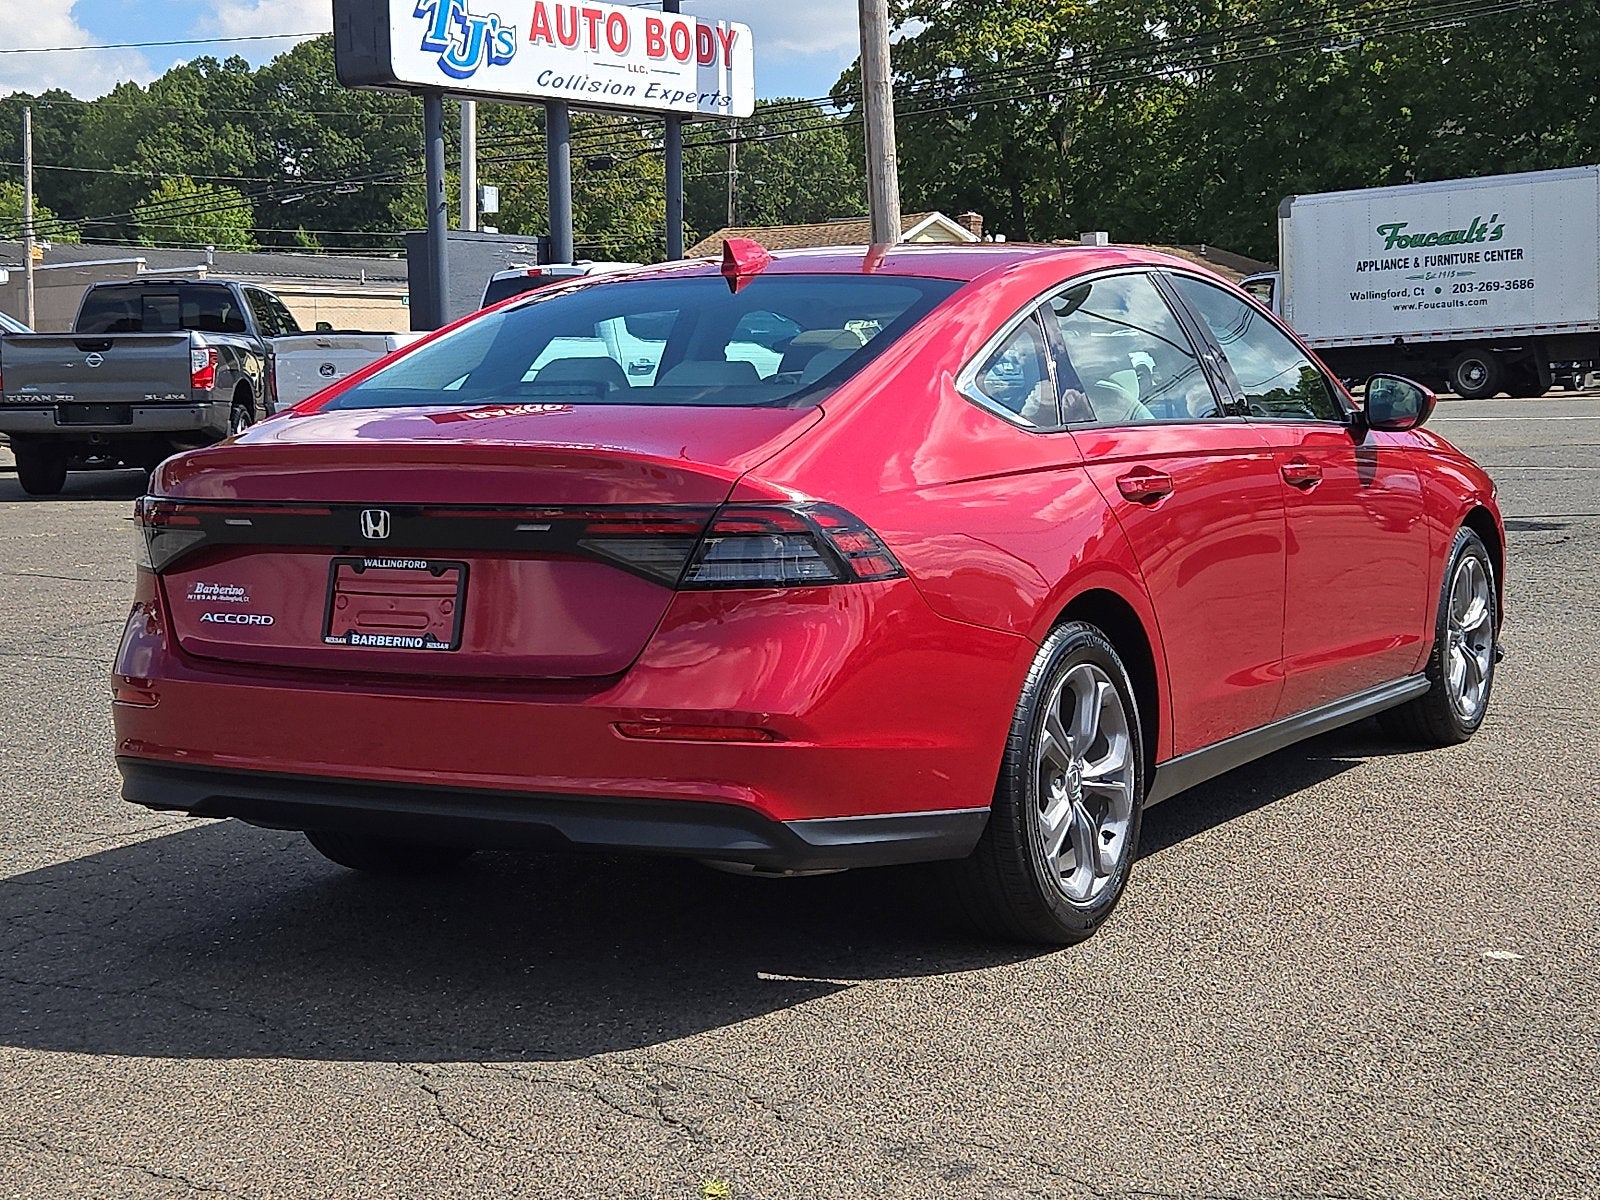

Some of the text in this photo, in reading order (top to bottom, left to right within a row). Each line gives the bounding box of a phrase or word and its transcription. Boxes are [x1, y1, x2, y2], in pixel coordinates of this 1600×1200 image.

[413, 0, 737, 79] TJ's AUTO BODY
[536, 70, 732, 108] Collision Experts
[1376, 213, 1506, 250] Foucault's
[1356, 249, 1524, 273] APPLIANCE & FURNITURE CENTER
[1350, 279, 1535, 301] Wallingford, Ct 203-269-3686
[1392, 298, 1488, 312] www.Foucaults.com
[6, 394, 52, 402] TITAN
[363, 559, 427, 569] WALLINGFORD
[194, 582, 245, 596] Barberino
[200, 612, 274, 625] ACCORD
[351, 634, 424, 648] BARBERINO
